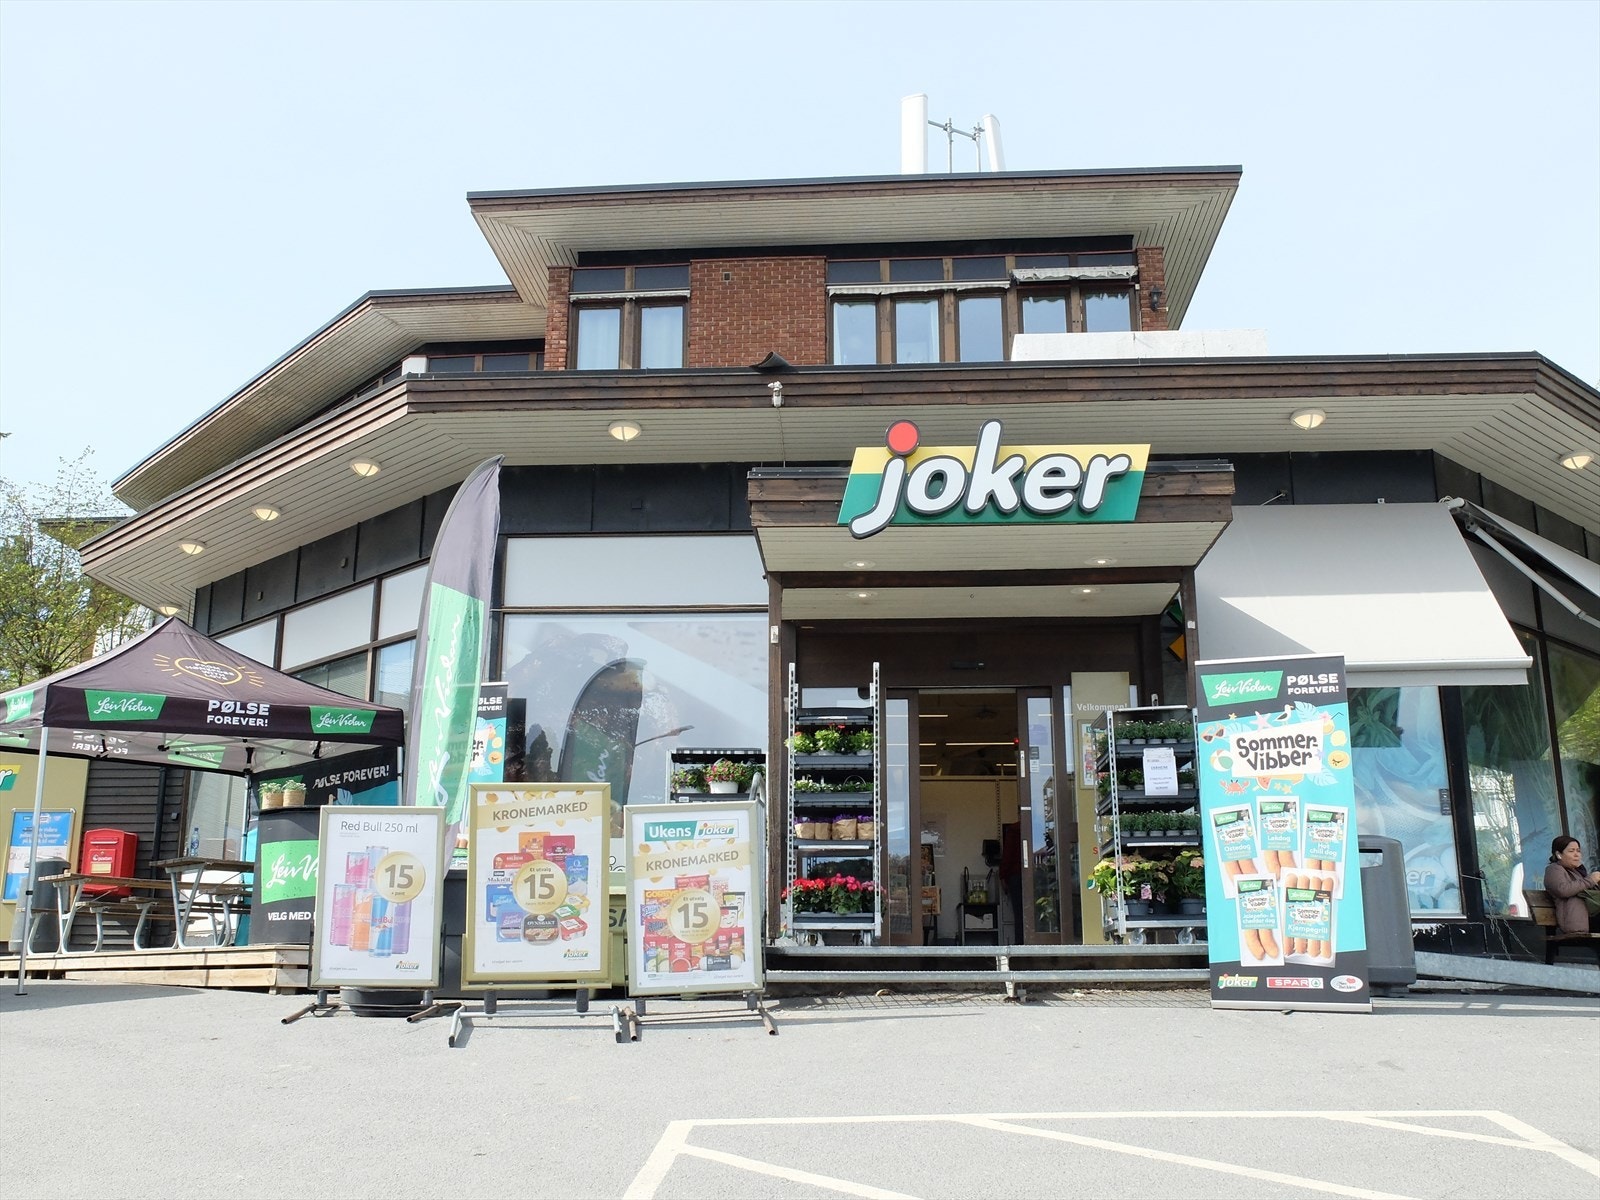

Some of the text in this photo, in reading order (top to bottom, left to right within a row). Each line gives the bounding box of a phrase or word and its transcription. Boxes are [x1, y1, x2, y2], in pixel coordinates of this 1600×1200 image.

[848, 418, 1132, 539] joker
[1234, 678, 1273, 695] Vidar
[1286, 673, 1339, 686] PØLSE
[1287, 685, 1340, 695] FOREVER!
[118, 698, 155, 713] Vidar
[207, 700, 271, 715] PØLSE
[478, 696, 503, 705] ØLSE
[206, 715, 268, 727] FOREVER!
[336, 713, 368, 727] Vidar
[343, 765, 390, 783] FOREVER!
[492, 801, 588, 821] KRONEMARKED
[340, 821, 418, 833] Red Bull 250 ml
[649, 822, 731, 838] Ukens joker
[646, 850, 739, 871] KRONEMARKED
[384, 864, 414, 889] 15
[523, 874, 555, 900] 15
[267, 912, 287, 920] VELG
[288, 911, 311, 920] MED
[677, 902, 709, 929] 15
[1218, 973, 1253, 989] joker
[1274, 979, 1310, 987] SPAR
